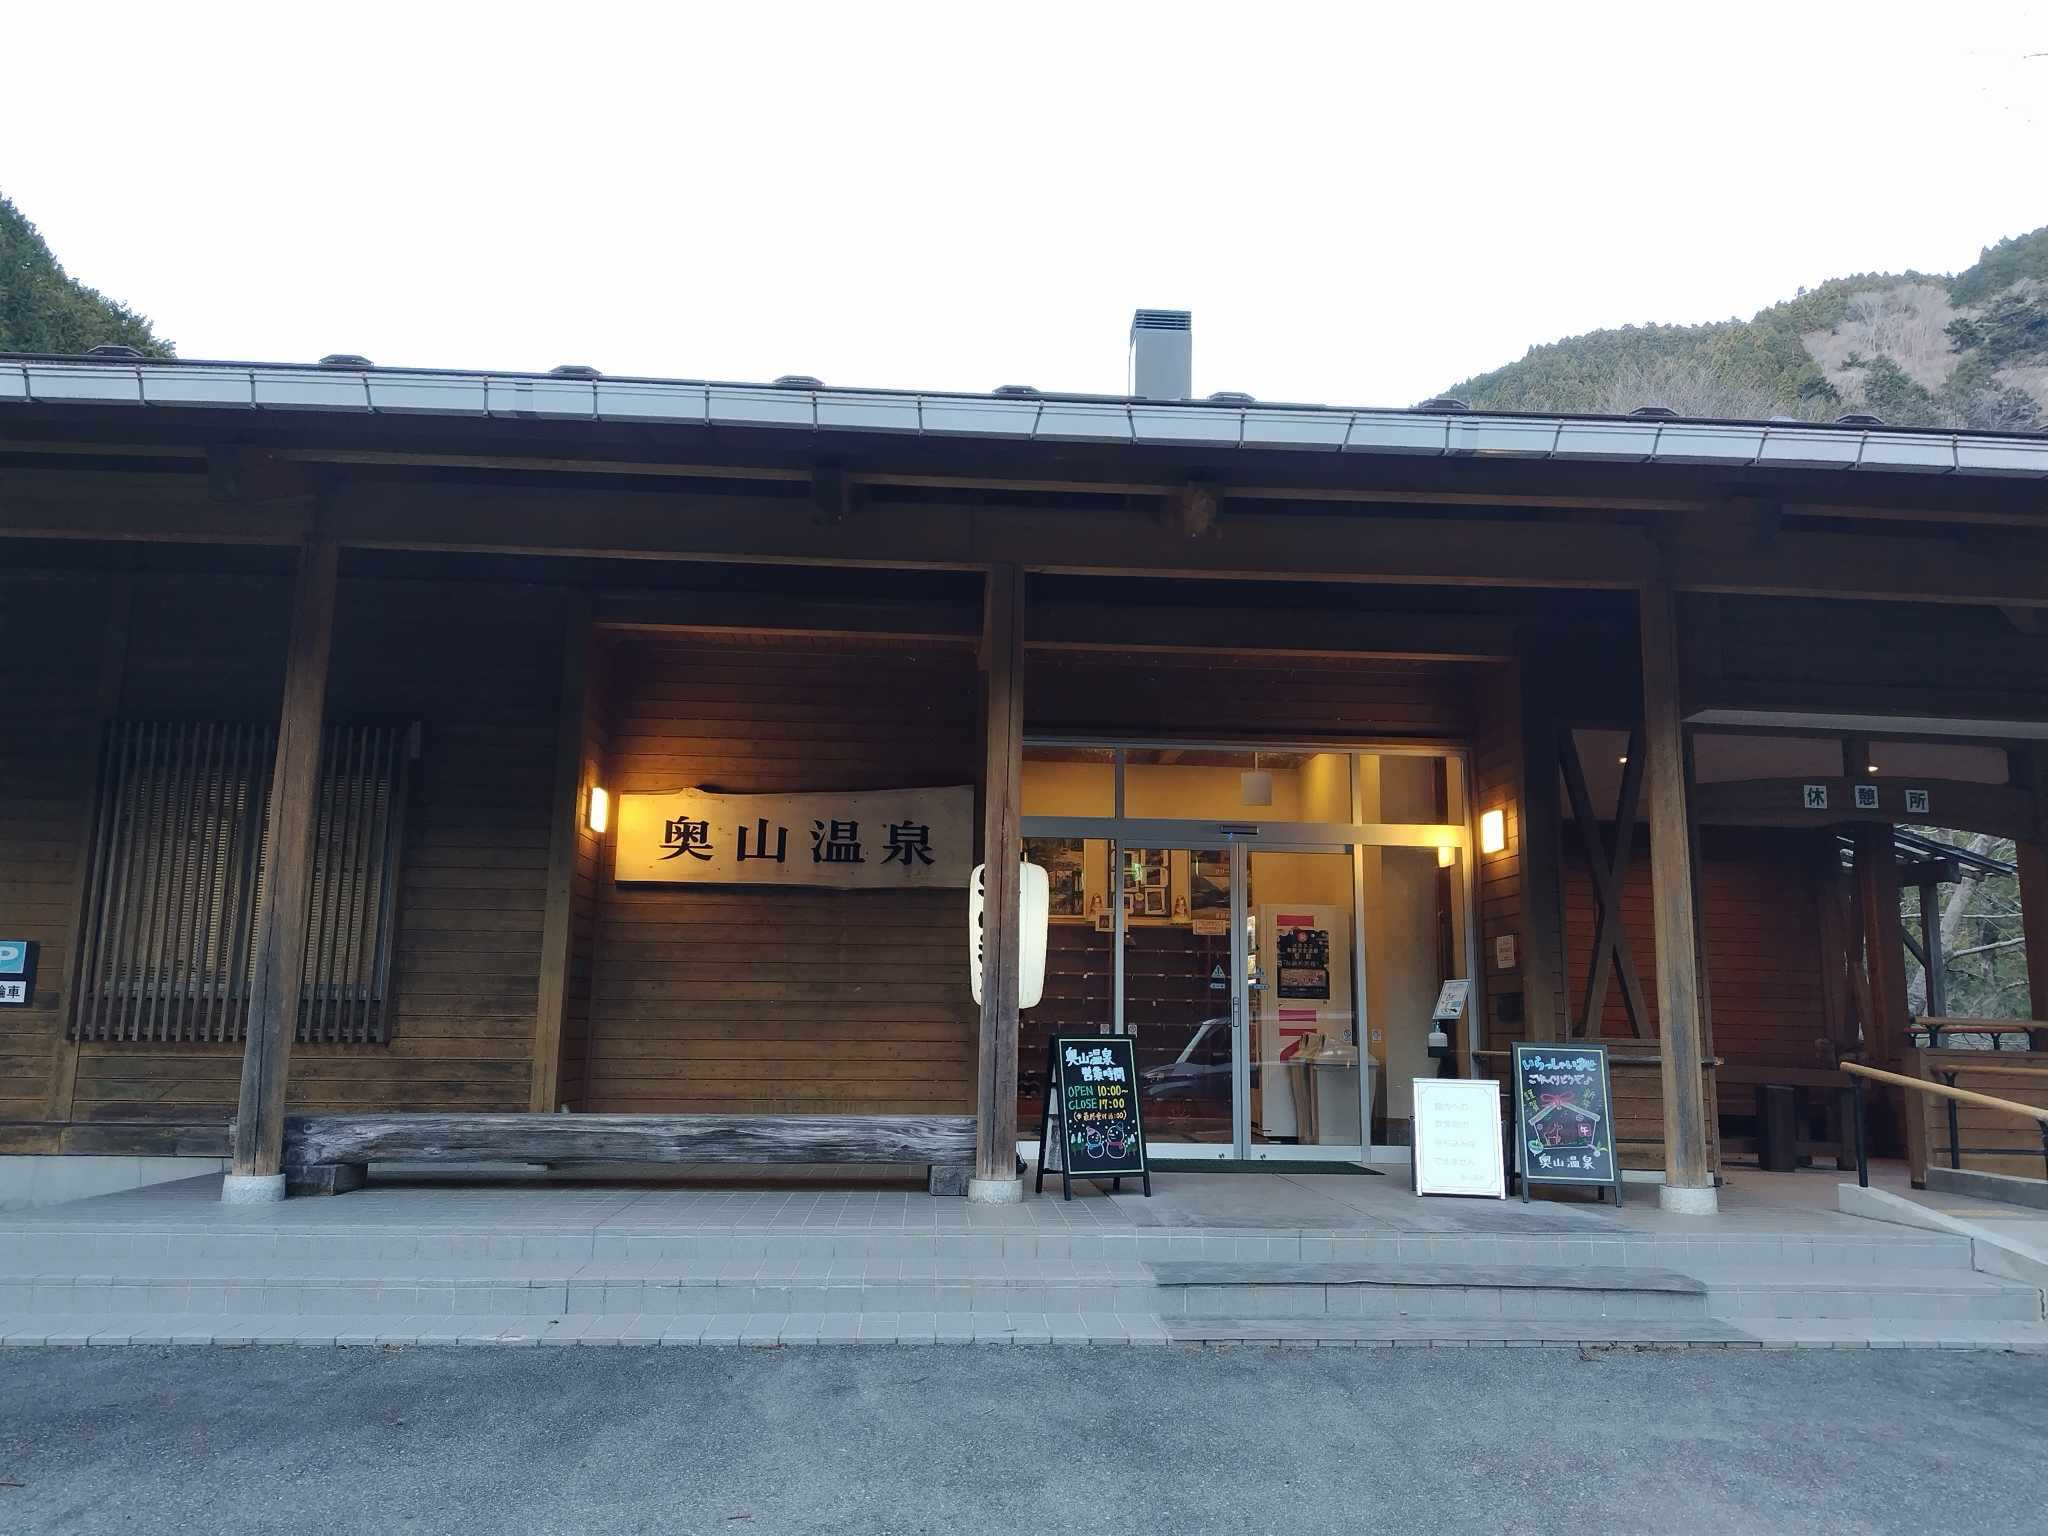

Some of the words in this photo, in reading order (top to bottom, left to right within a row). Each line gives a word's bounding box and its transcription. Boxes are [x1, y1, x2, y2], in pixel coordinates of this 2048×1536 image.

[1807, 787, 1926, 811] 休憩所
[657, 815, 936, 866] 奥山温泉
[1065, 1046, 1116, 1067] 奥山温泉
[1081, 1066, 1126, 1082] 営業時間
[1068, 1085, 1094, 1098] OPEN
[1068, 1099, 1098, 1111] CLOSE
[1099, 1098, 1125, 1111] 17:00
[1538, 1153, 1596, 1170] 奥山温泉
